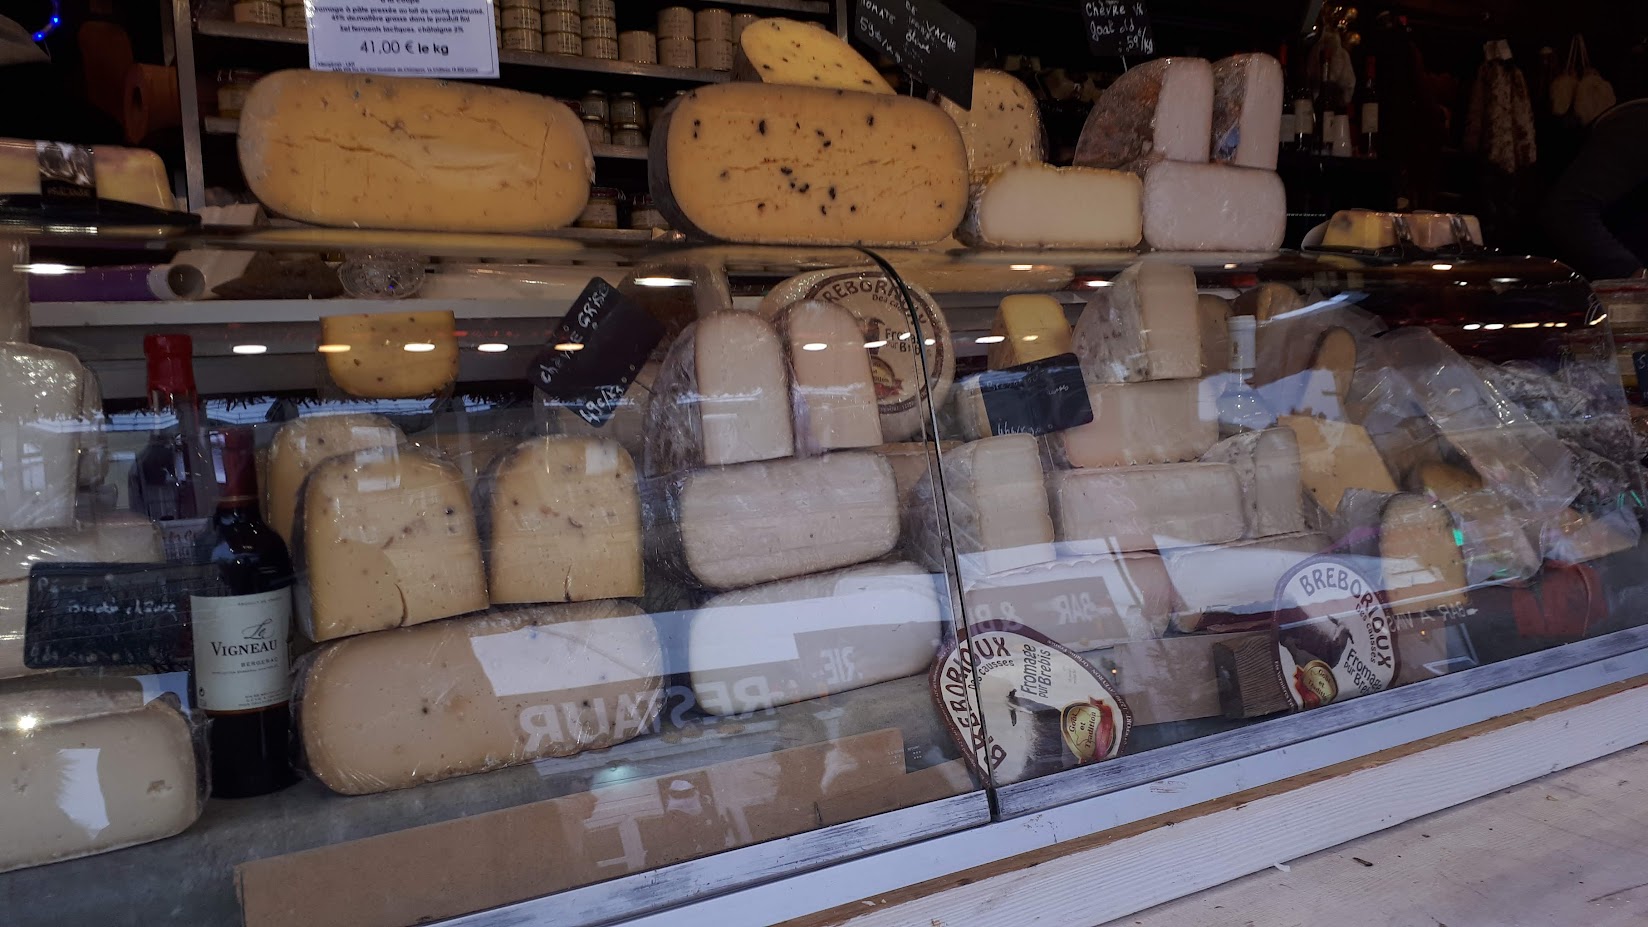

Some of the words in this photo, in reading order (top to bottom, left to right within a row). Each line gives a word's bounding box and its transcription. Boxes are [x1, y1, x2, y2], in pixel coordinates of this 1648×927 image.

[360, 40, 400, 56] 41,00
[405, 40, 414, 55] €
[418, 43, 430, 55] le
[433, 42, 449, 56] kg
[1299, 567, 1392, 669] BREBORIOUX
[211, 640, 278, 657] VIGNEAU
[1037, 648, 1052, 687] Brebis
[1020, 643, 1038, 696] Fromage
[1085, 711, 1097, 749] Tradition
